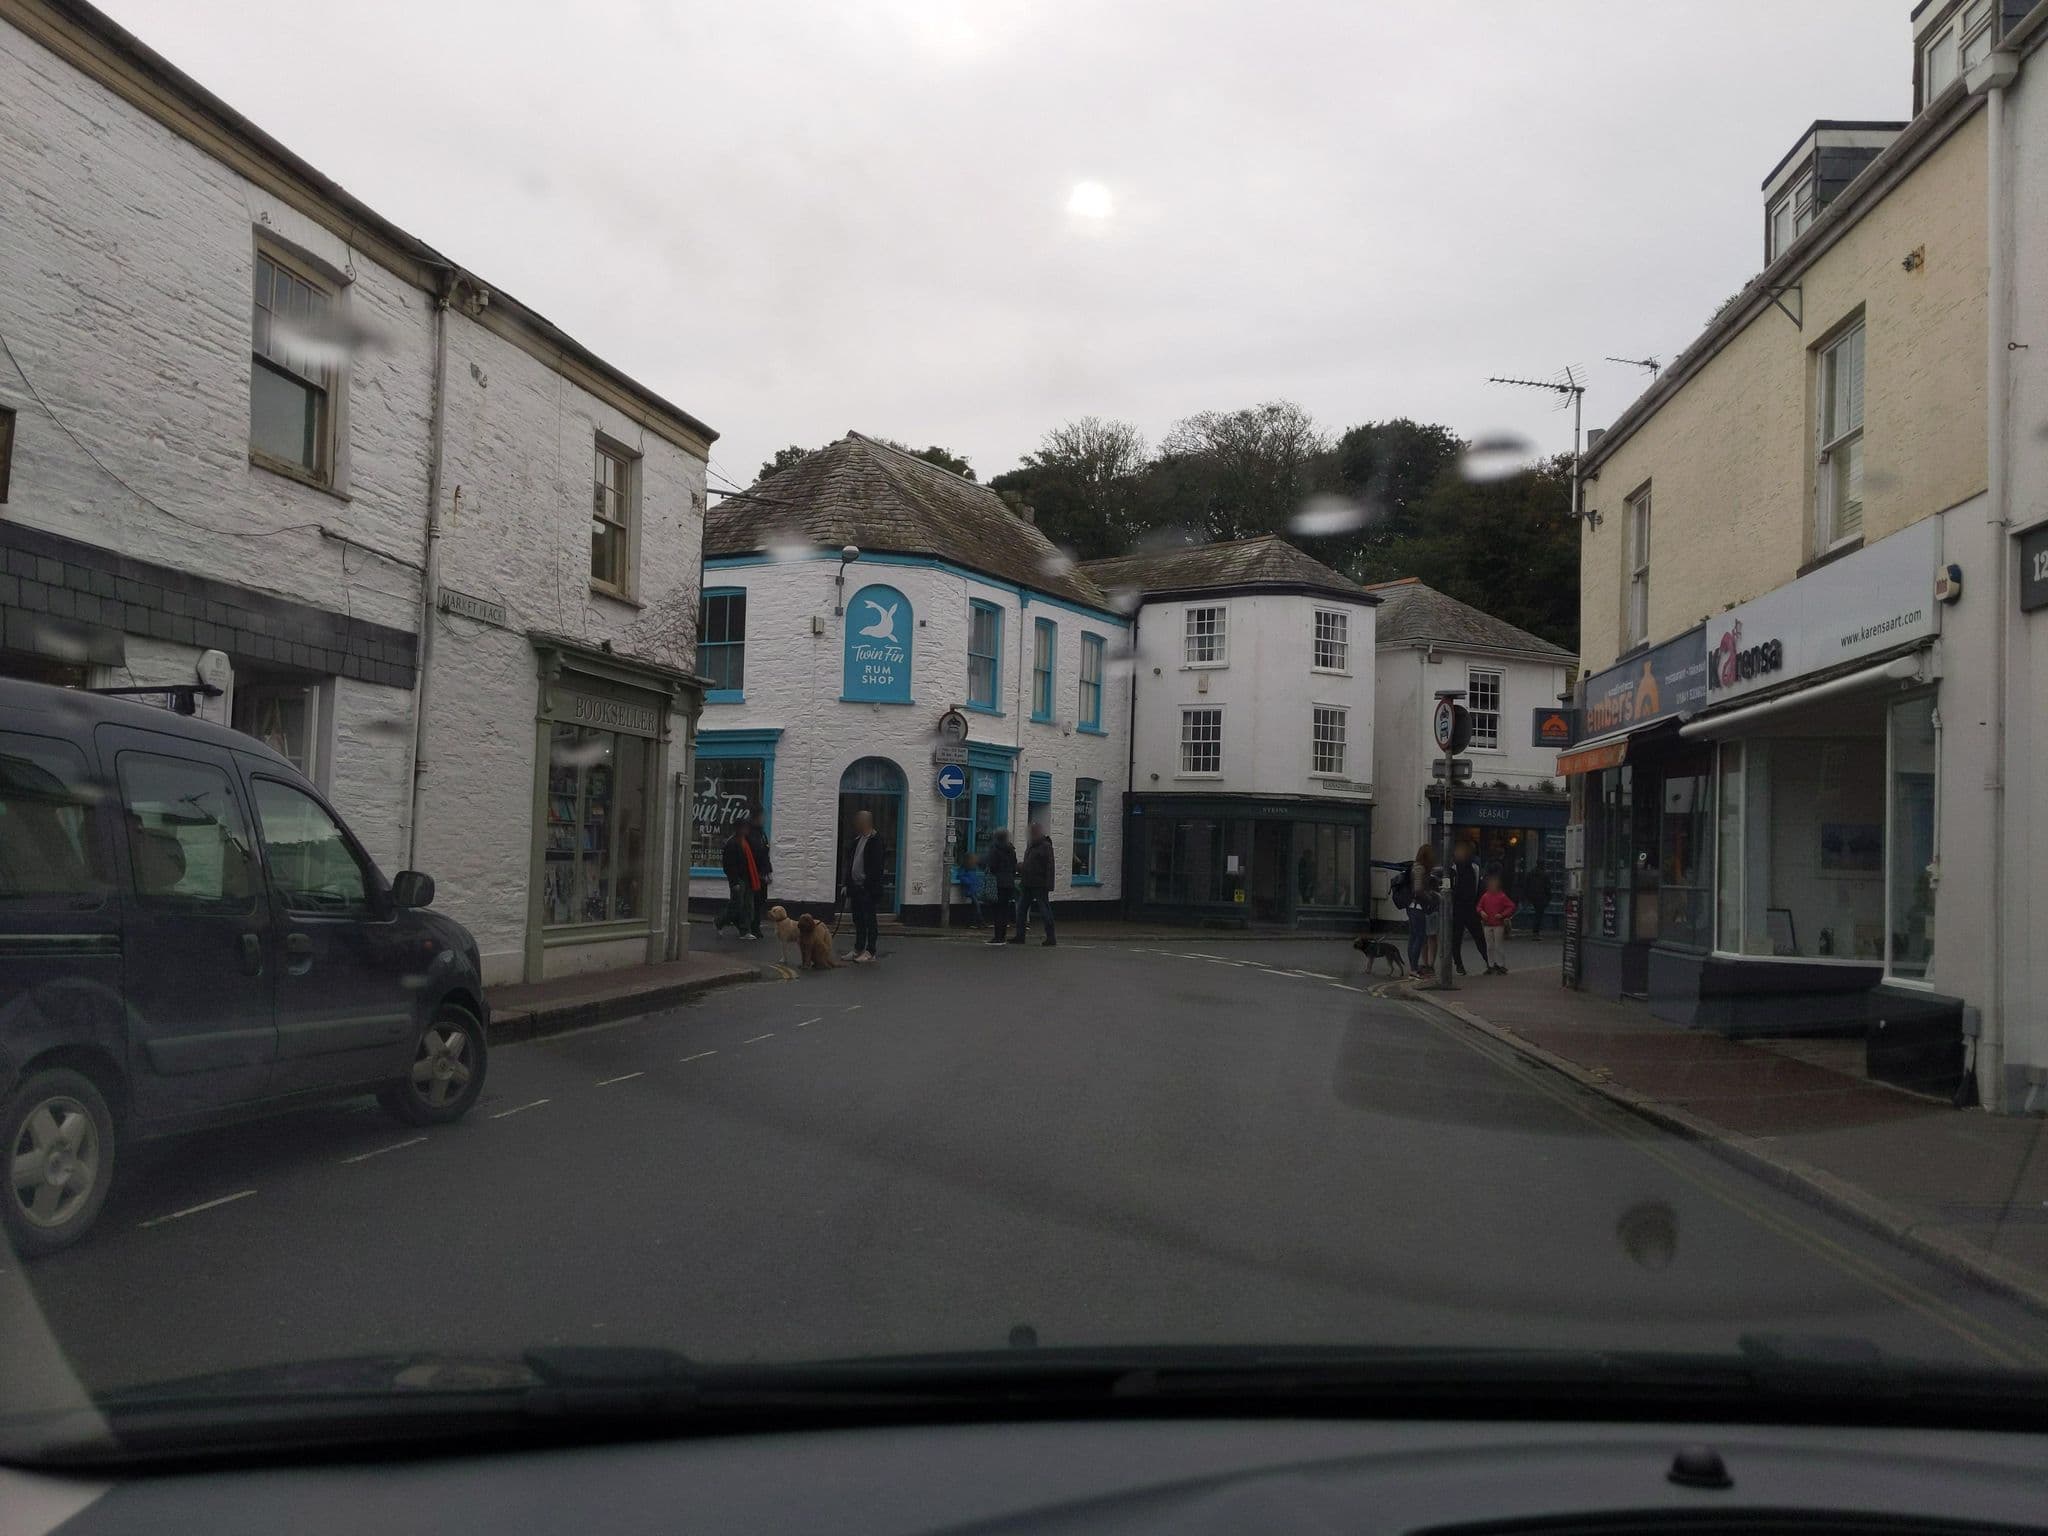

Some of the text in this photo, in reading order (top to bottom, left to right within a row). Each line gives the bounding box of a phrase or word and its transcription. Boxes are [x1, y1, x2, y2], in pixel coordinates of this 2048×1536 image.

[441, 593, 476, 615] MARKET
[1840, 609, 1922, 648] www.karensaart.com
[851, 644, 905, 663] Twin Fin
[861, 675, 894, 685] SHOP
[864, 665, 892, 675] RUM
[575, 696, 656, 732] BOOKSELLER
[1586, 690, 1633, 734] embers
[720, 792, 751, 825] Fin
[1478, 808, 1511, 820] SEASALT
[699, 825, 721, 834] RUM
